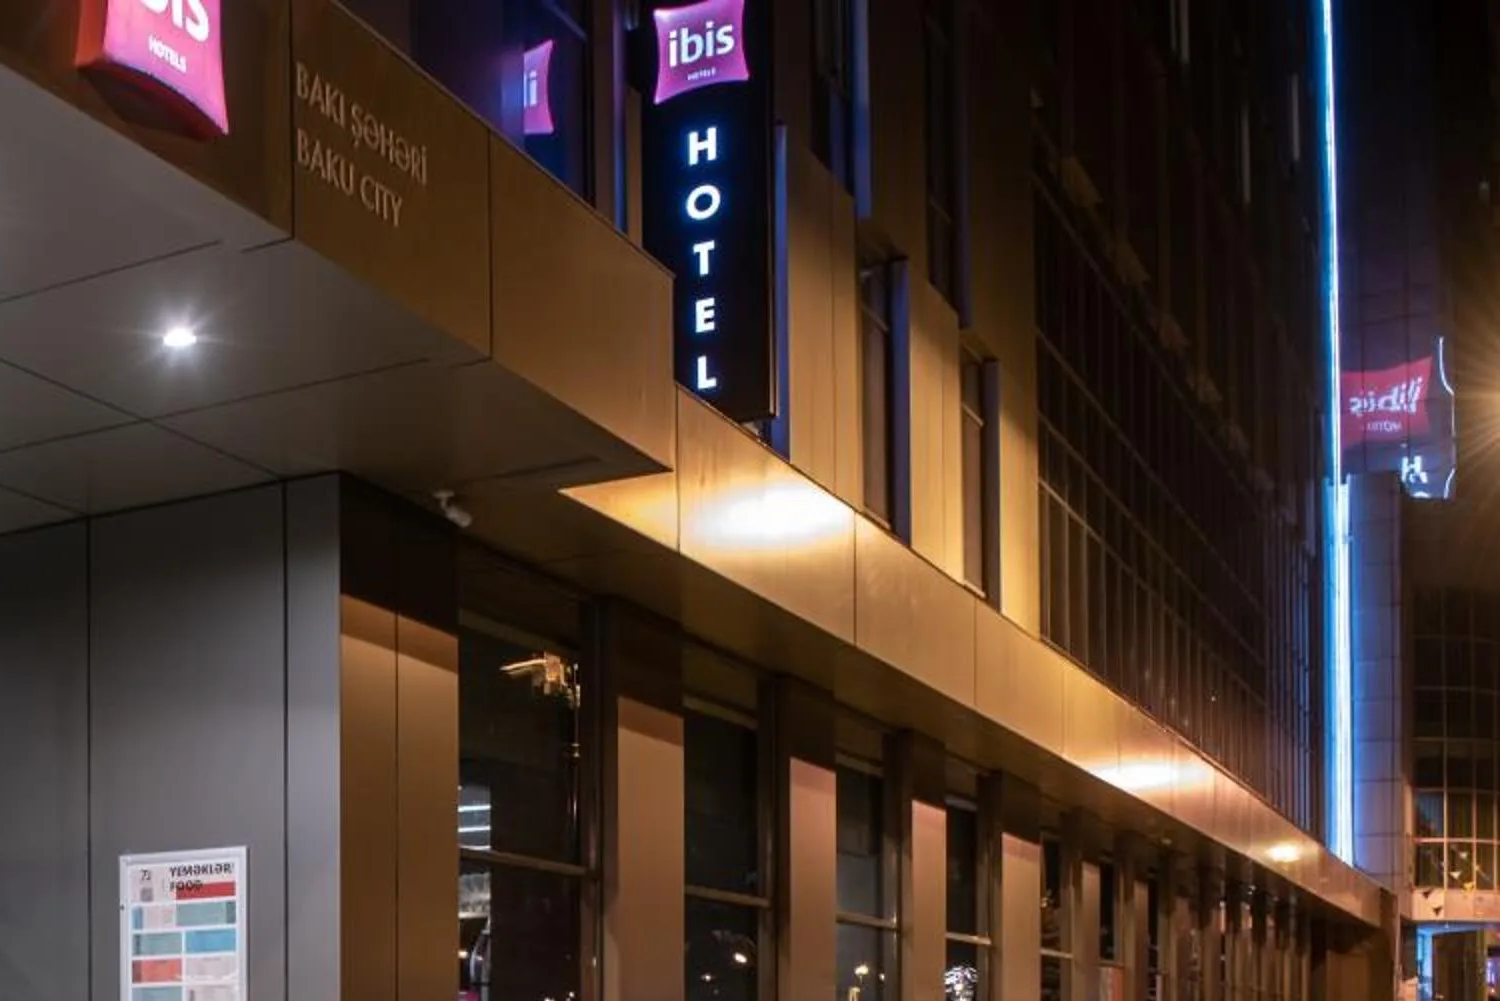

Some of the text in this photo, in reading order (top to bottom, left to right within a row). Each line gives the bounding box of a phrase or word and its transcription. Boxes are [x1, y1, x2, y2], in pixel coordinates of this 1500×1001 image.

[148, 34, 187, 73] HOTELS
[668, 20, 736, 67] ibis
[296, 61, 346, 129] BAKI
[297, 127, 403, 228] BAKU CITY
[685, 126, 721, 391] HOTEL
